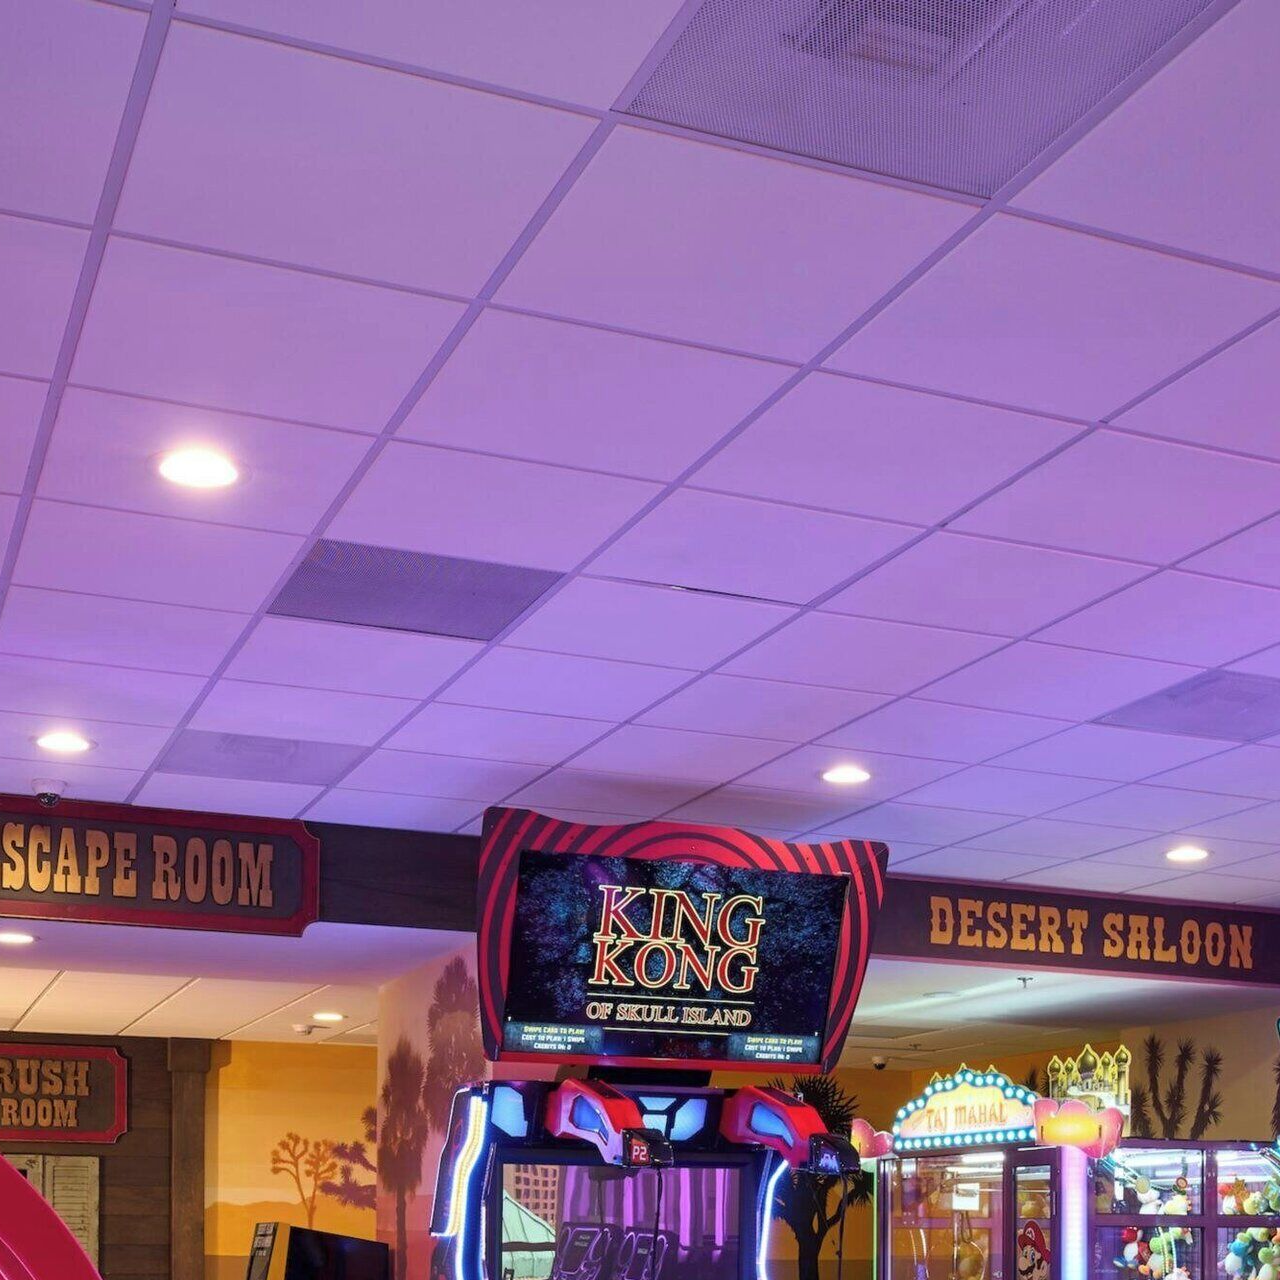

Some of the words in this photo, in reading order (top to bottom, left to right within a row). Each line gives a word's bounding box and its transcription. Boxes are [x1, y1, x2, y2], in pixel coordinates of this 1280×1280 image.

[151, 834, 275, 908] ROOM
[593, 884, 766, 948] KING
[930, 895, 1089, 956] DESERT
[1102, 912, 1254, 970] SALOON
[587, 937, 759, 994] KONG
[586, 1001, 613, 1021] OF
[616, 1002, 679, 1024] SKULL
[681, 1006, 752, 1027] ISLAND
[0, 1098, 78, 1128] ROOM
[926, 1106, 948, 1130] TAJ
[955, 1102, 1008, 1126] MAHAL
[631, 1145, 647, 1161] P2
